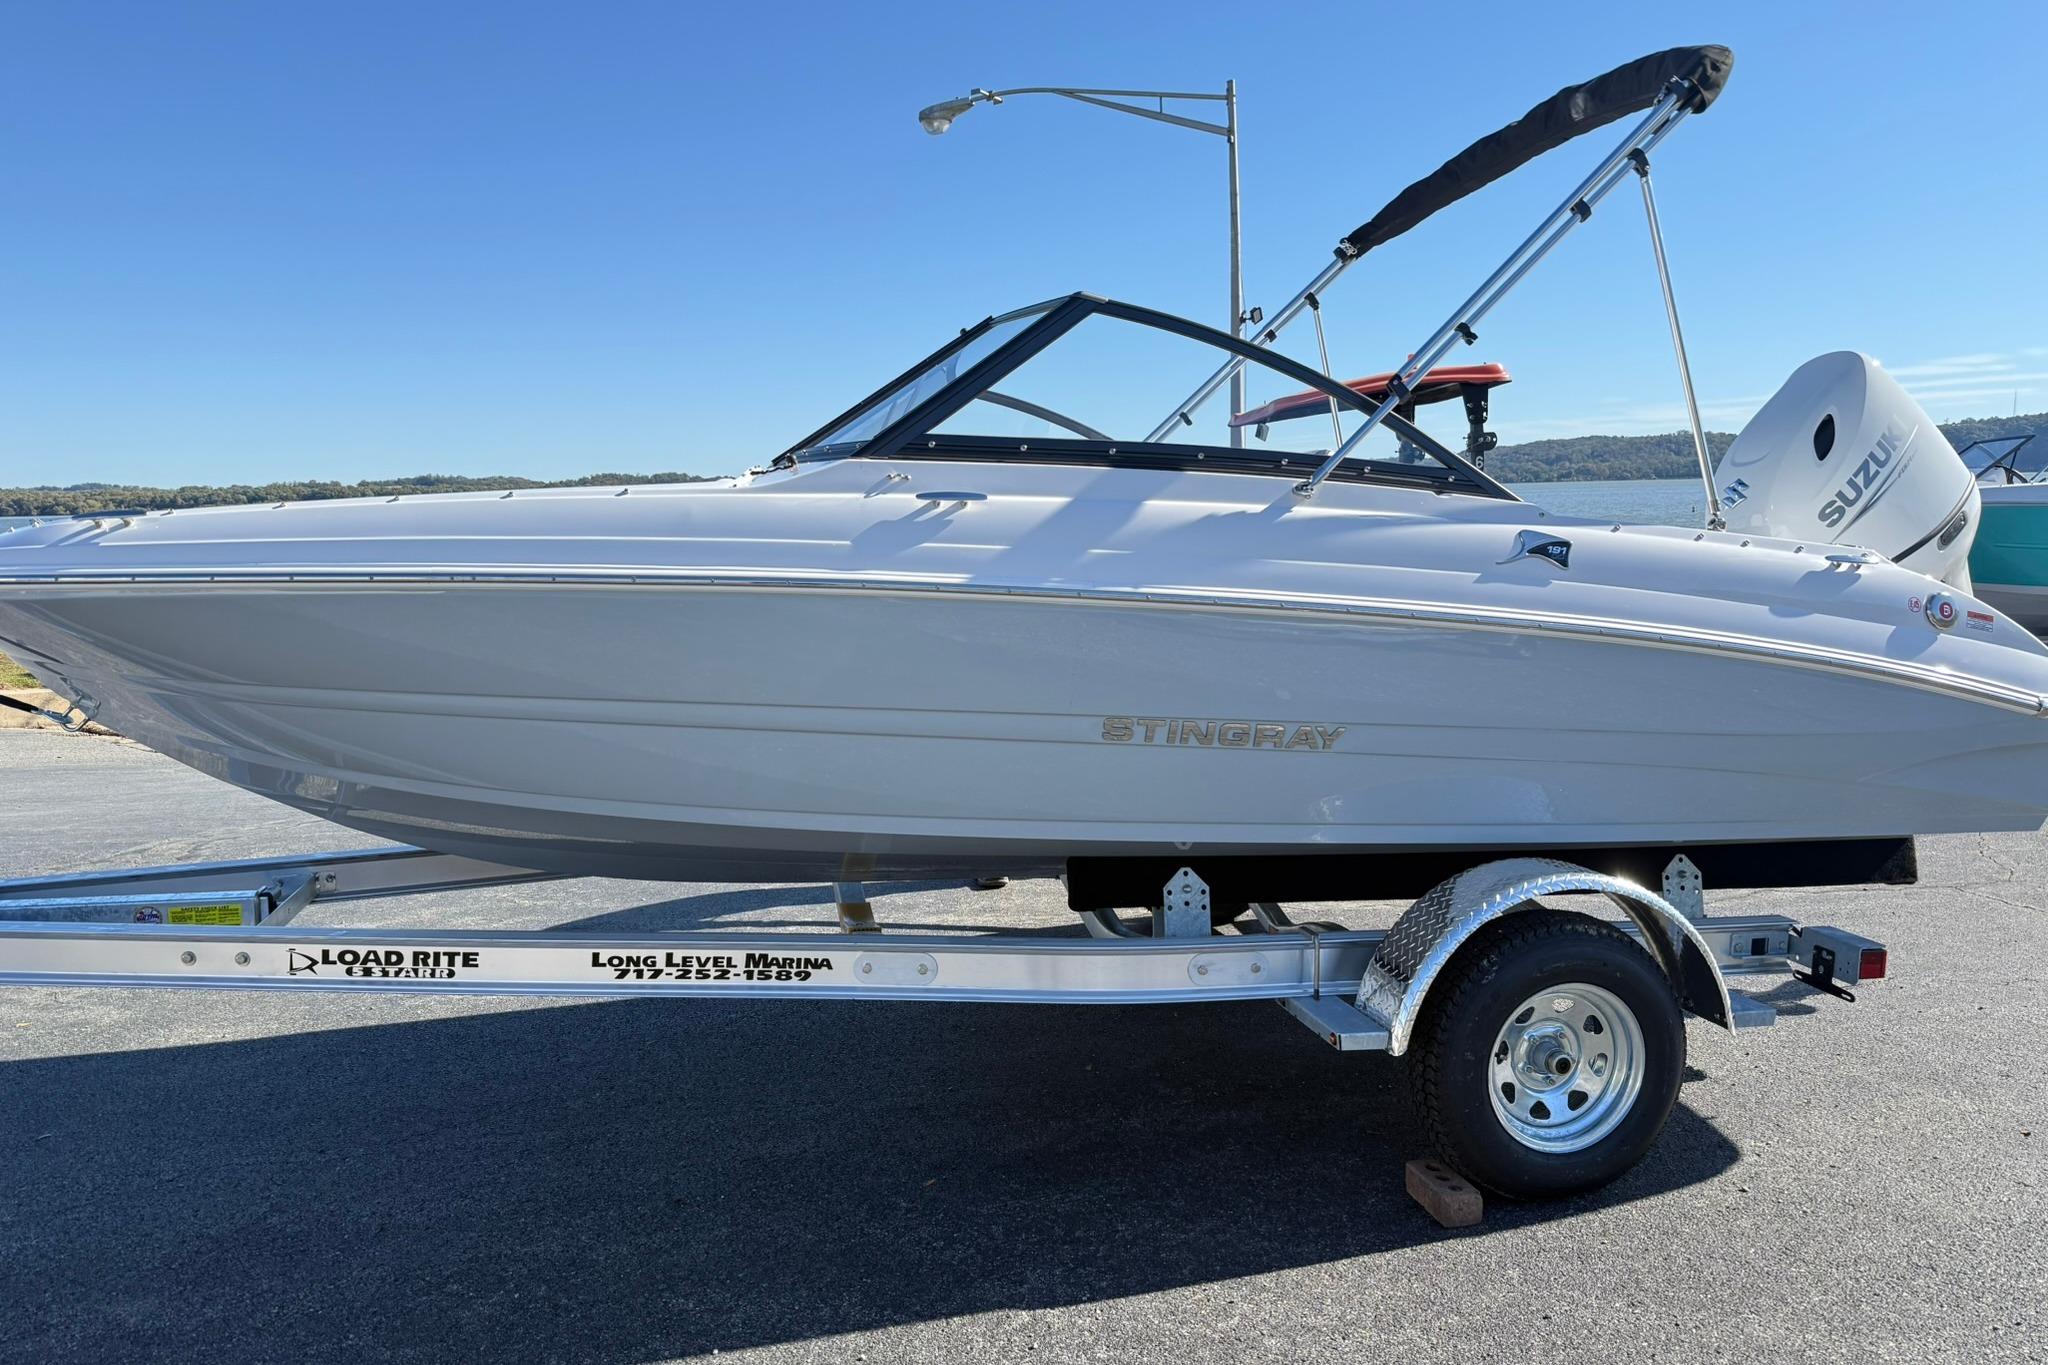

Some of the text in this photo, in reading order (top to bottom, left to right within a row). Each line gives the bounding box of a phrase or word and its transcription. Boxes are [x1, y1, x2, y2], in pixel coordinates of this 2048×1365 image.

[1475, 455, 1484, 469] 6
[1818, 415, 1908, 528] SUZUK
[1546, 545, 1567, 555] 191
[1101, 717, 1347, 750] STINGRAY
[321, 949, 480, 968] LOAD RITE
[351, 966, 449, 979] 5 STARR
[614, 968, 812, 982] 717-252-1589
